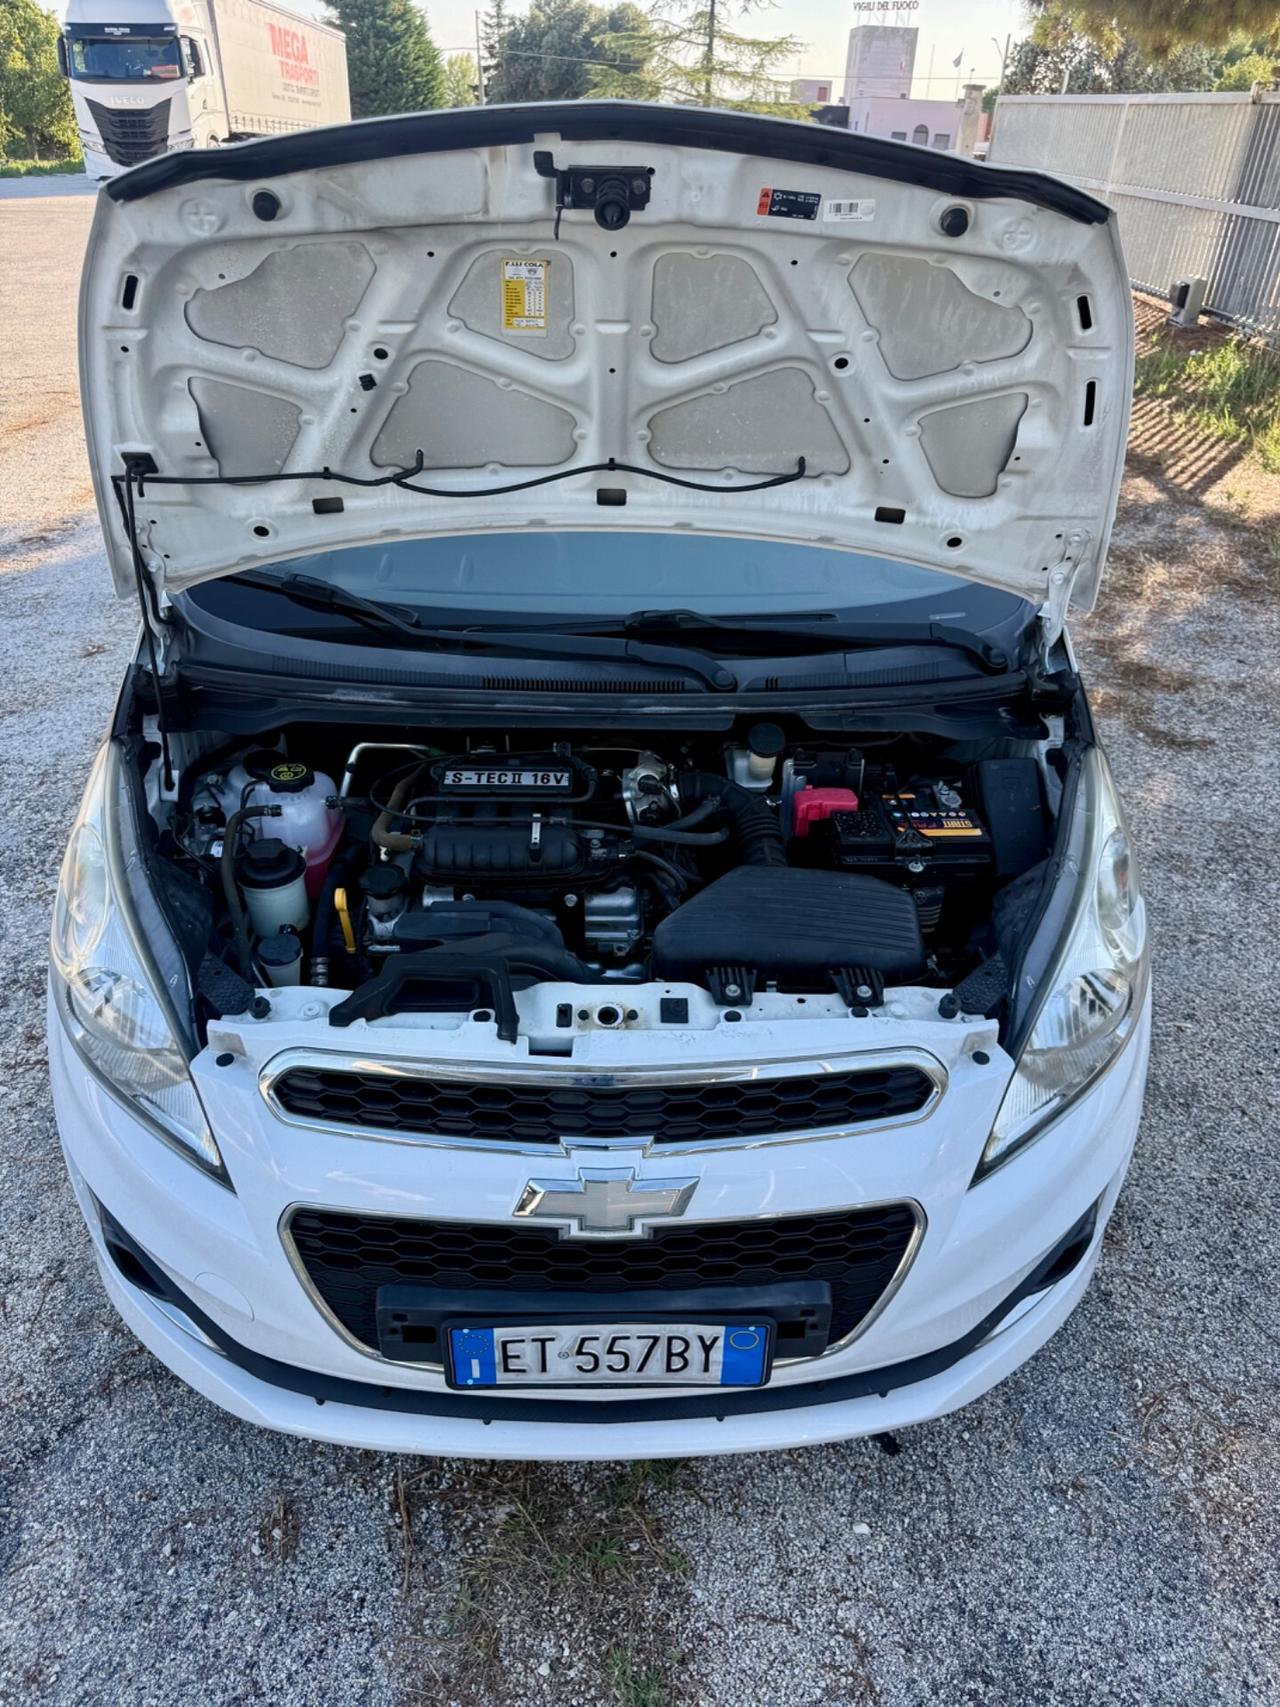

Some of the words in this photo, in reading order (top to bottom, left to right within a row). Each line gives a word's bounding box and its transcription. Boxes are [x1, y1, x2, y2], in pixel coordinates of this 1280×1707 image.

[853, 1, 875, 11] VIGILI
[877, 1, 889, 10] DEL
[892, 0, 919, 10] FUOCO
[265, 22, 309, 66] MEGA
[111, 96, 145, 105] IVECO
[532, 773, 565, 785] 16V
[500, 1335, 556, 1374] ET
[575, 1334, 720, 1374] 557BY
